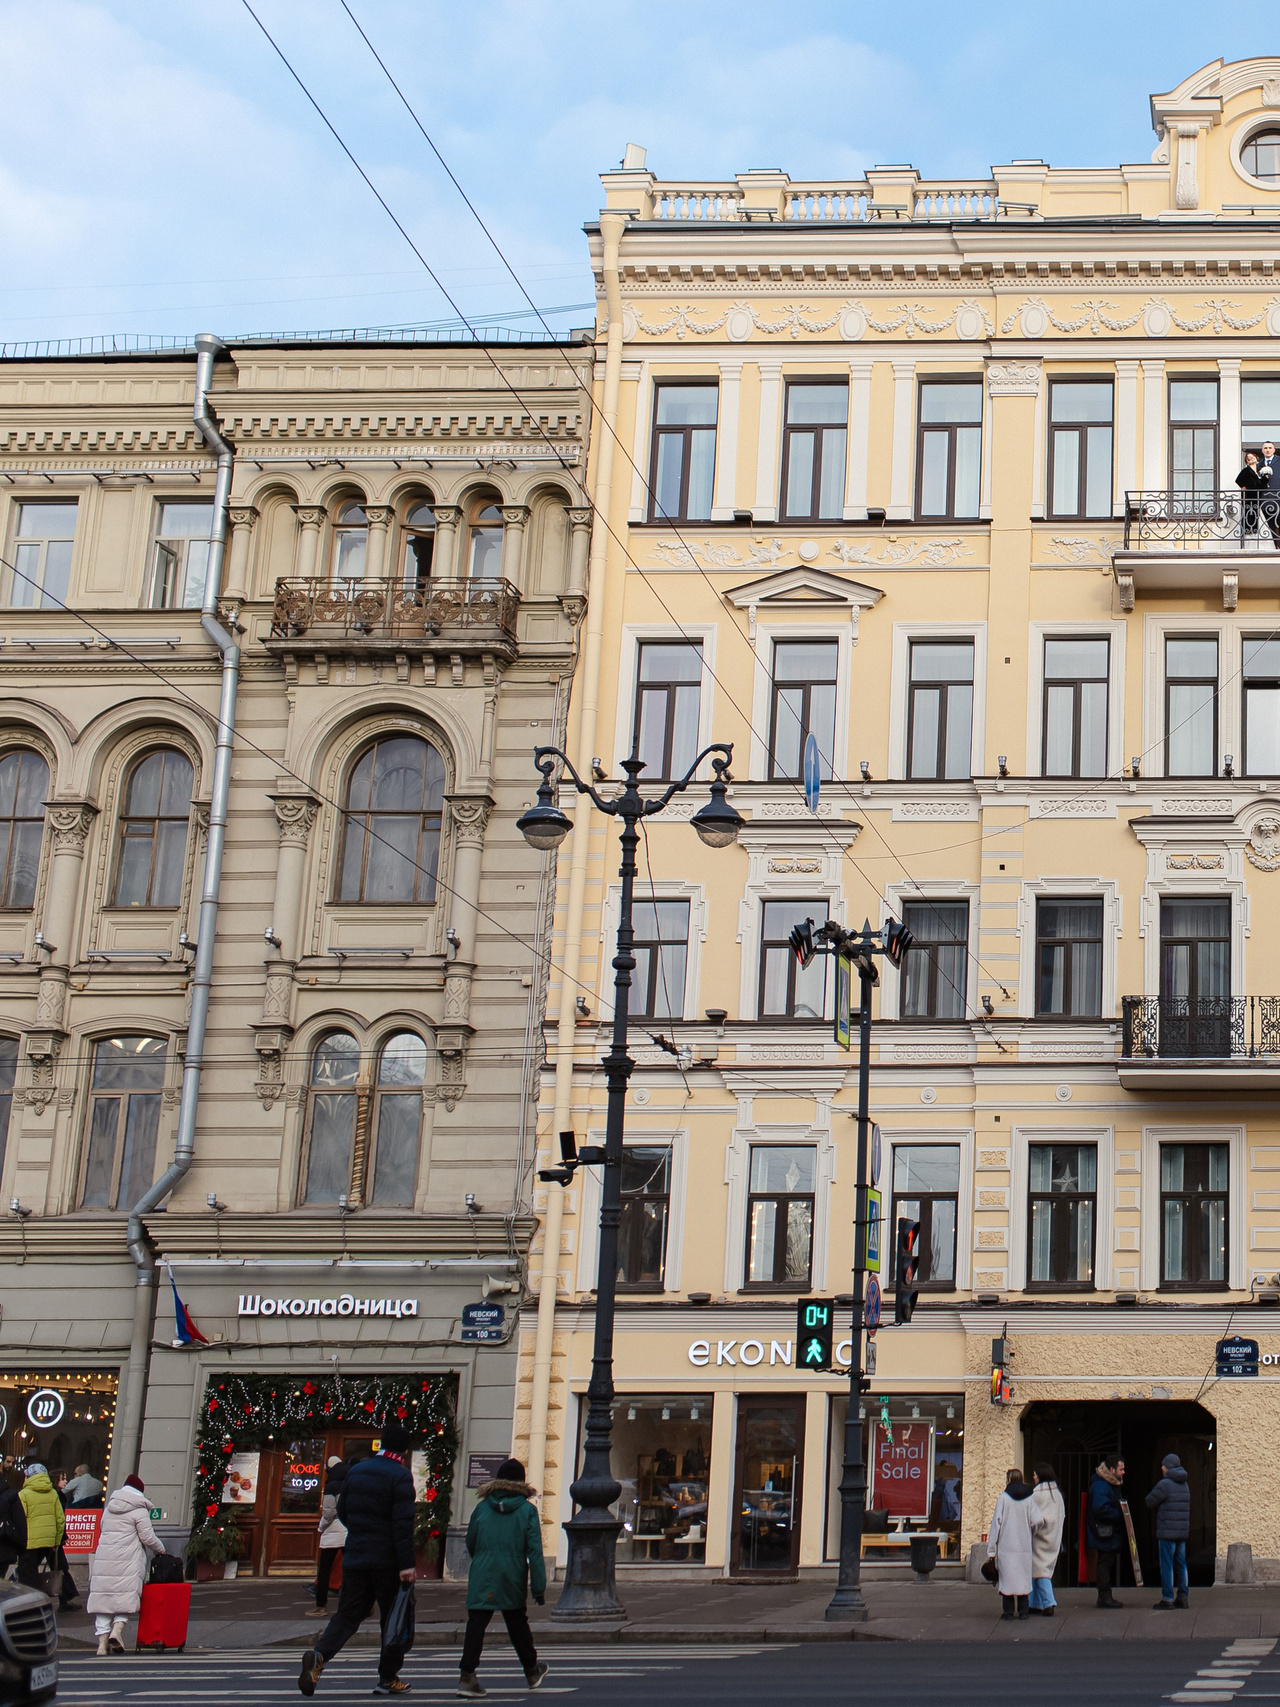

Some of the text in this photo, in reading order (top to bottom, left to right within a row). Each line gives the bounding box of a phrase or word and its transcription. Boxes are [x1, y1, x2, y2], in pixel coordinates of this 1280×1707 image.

[237, 1293, 418, 1318] Шоколадница
[469, 1309, 499, 1318] НЕВСКИЙ
[805, 1305, 828, 1327] 04
[476, 1330, 489, 1339] 100
[1223, 1345, 1252, 1354] НЕВСКИЙ
[1232, 1365, 1243, 1374] 102
[880, 1441, 924, 1459] Final
[289, 1464, 320, 1474] КОФЕ
[881, 1461, 921, 1479] Sale
[291, 1478, 319, 1490] to go
[65, 1514, 97, 1522] ВМЕСТЕ
[65, 1522, 96, 1530] ТЕПЛЕЕ
